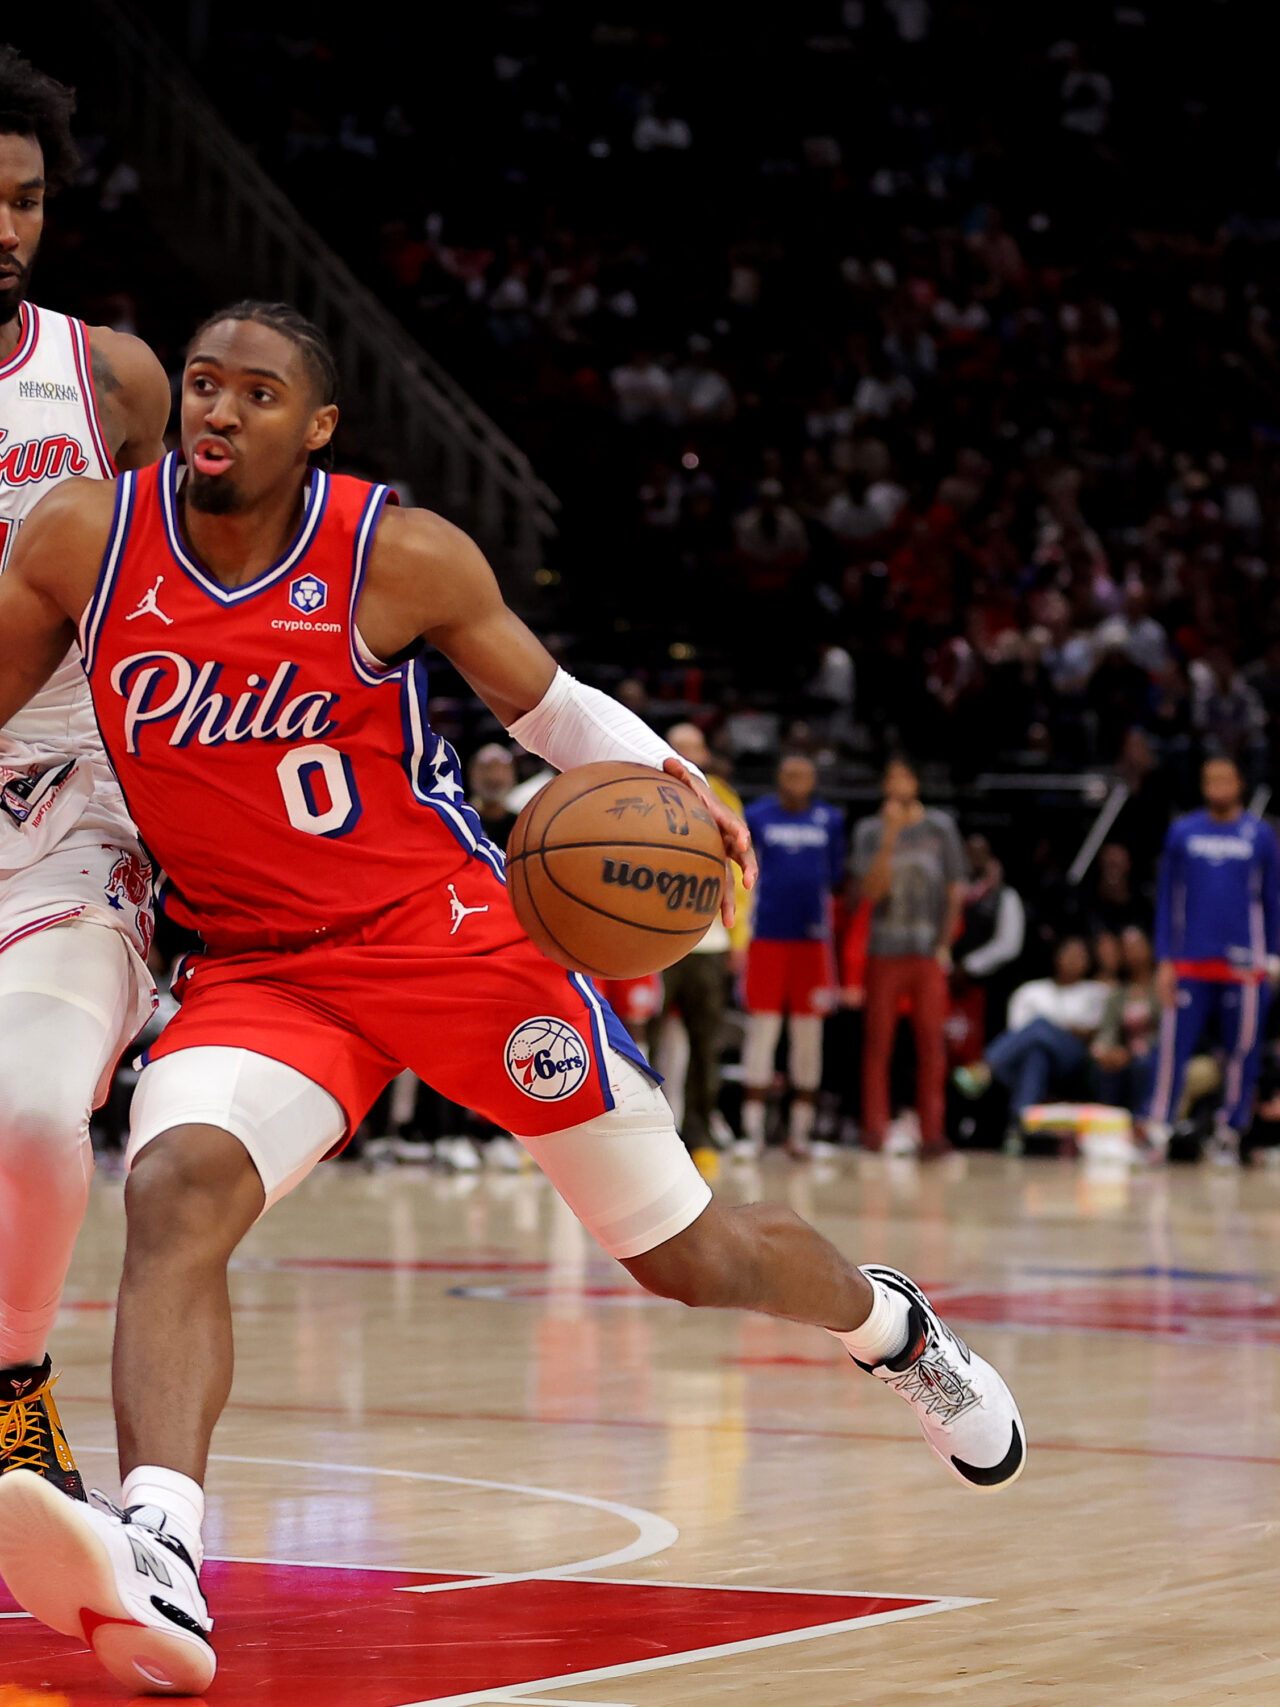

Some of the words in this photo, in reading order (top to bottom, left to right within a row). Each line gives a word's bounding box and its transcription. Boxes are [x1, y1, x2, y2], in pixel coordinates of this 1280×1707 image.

[19, 381, 77, 396] MEMORIAL
[20, 389, 78, 402] HERMANN
[271, 619, 341, 632] crypto.com
[110, 651, 340, 756] Phila
[276, 743, 363, 838] 0
[603, 857, 720, 914] Wilson
[514, 1050, 583, 1086] 76ers
